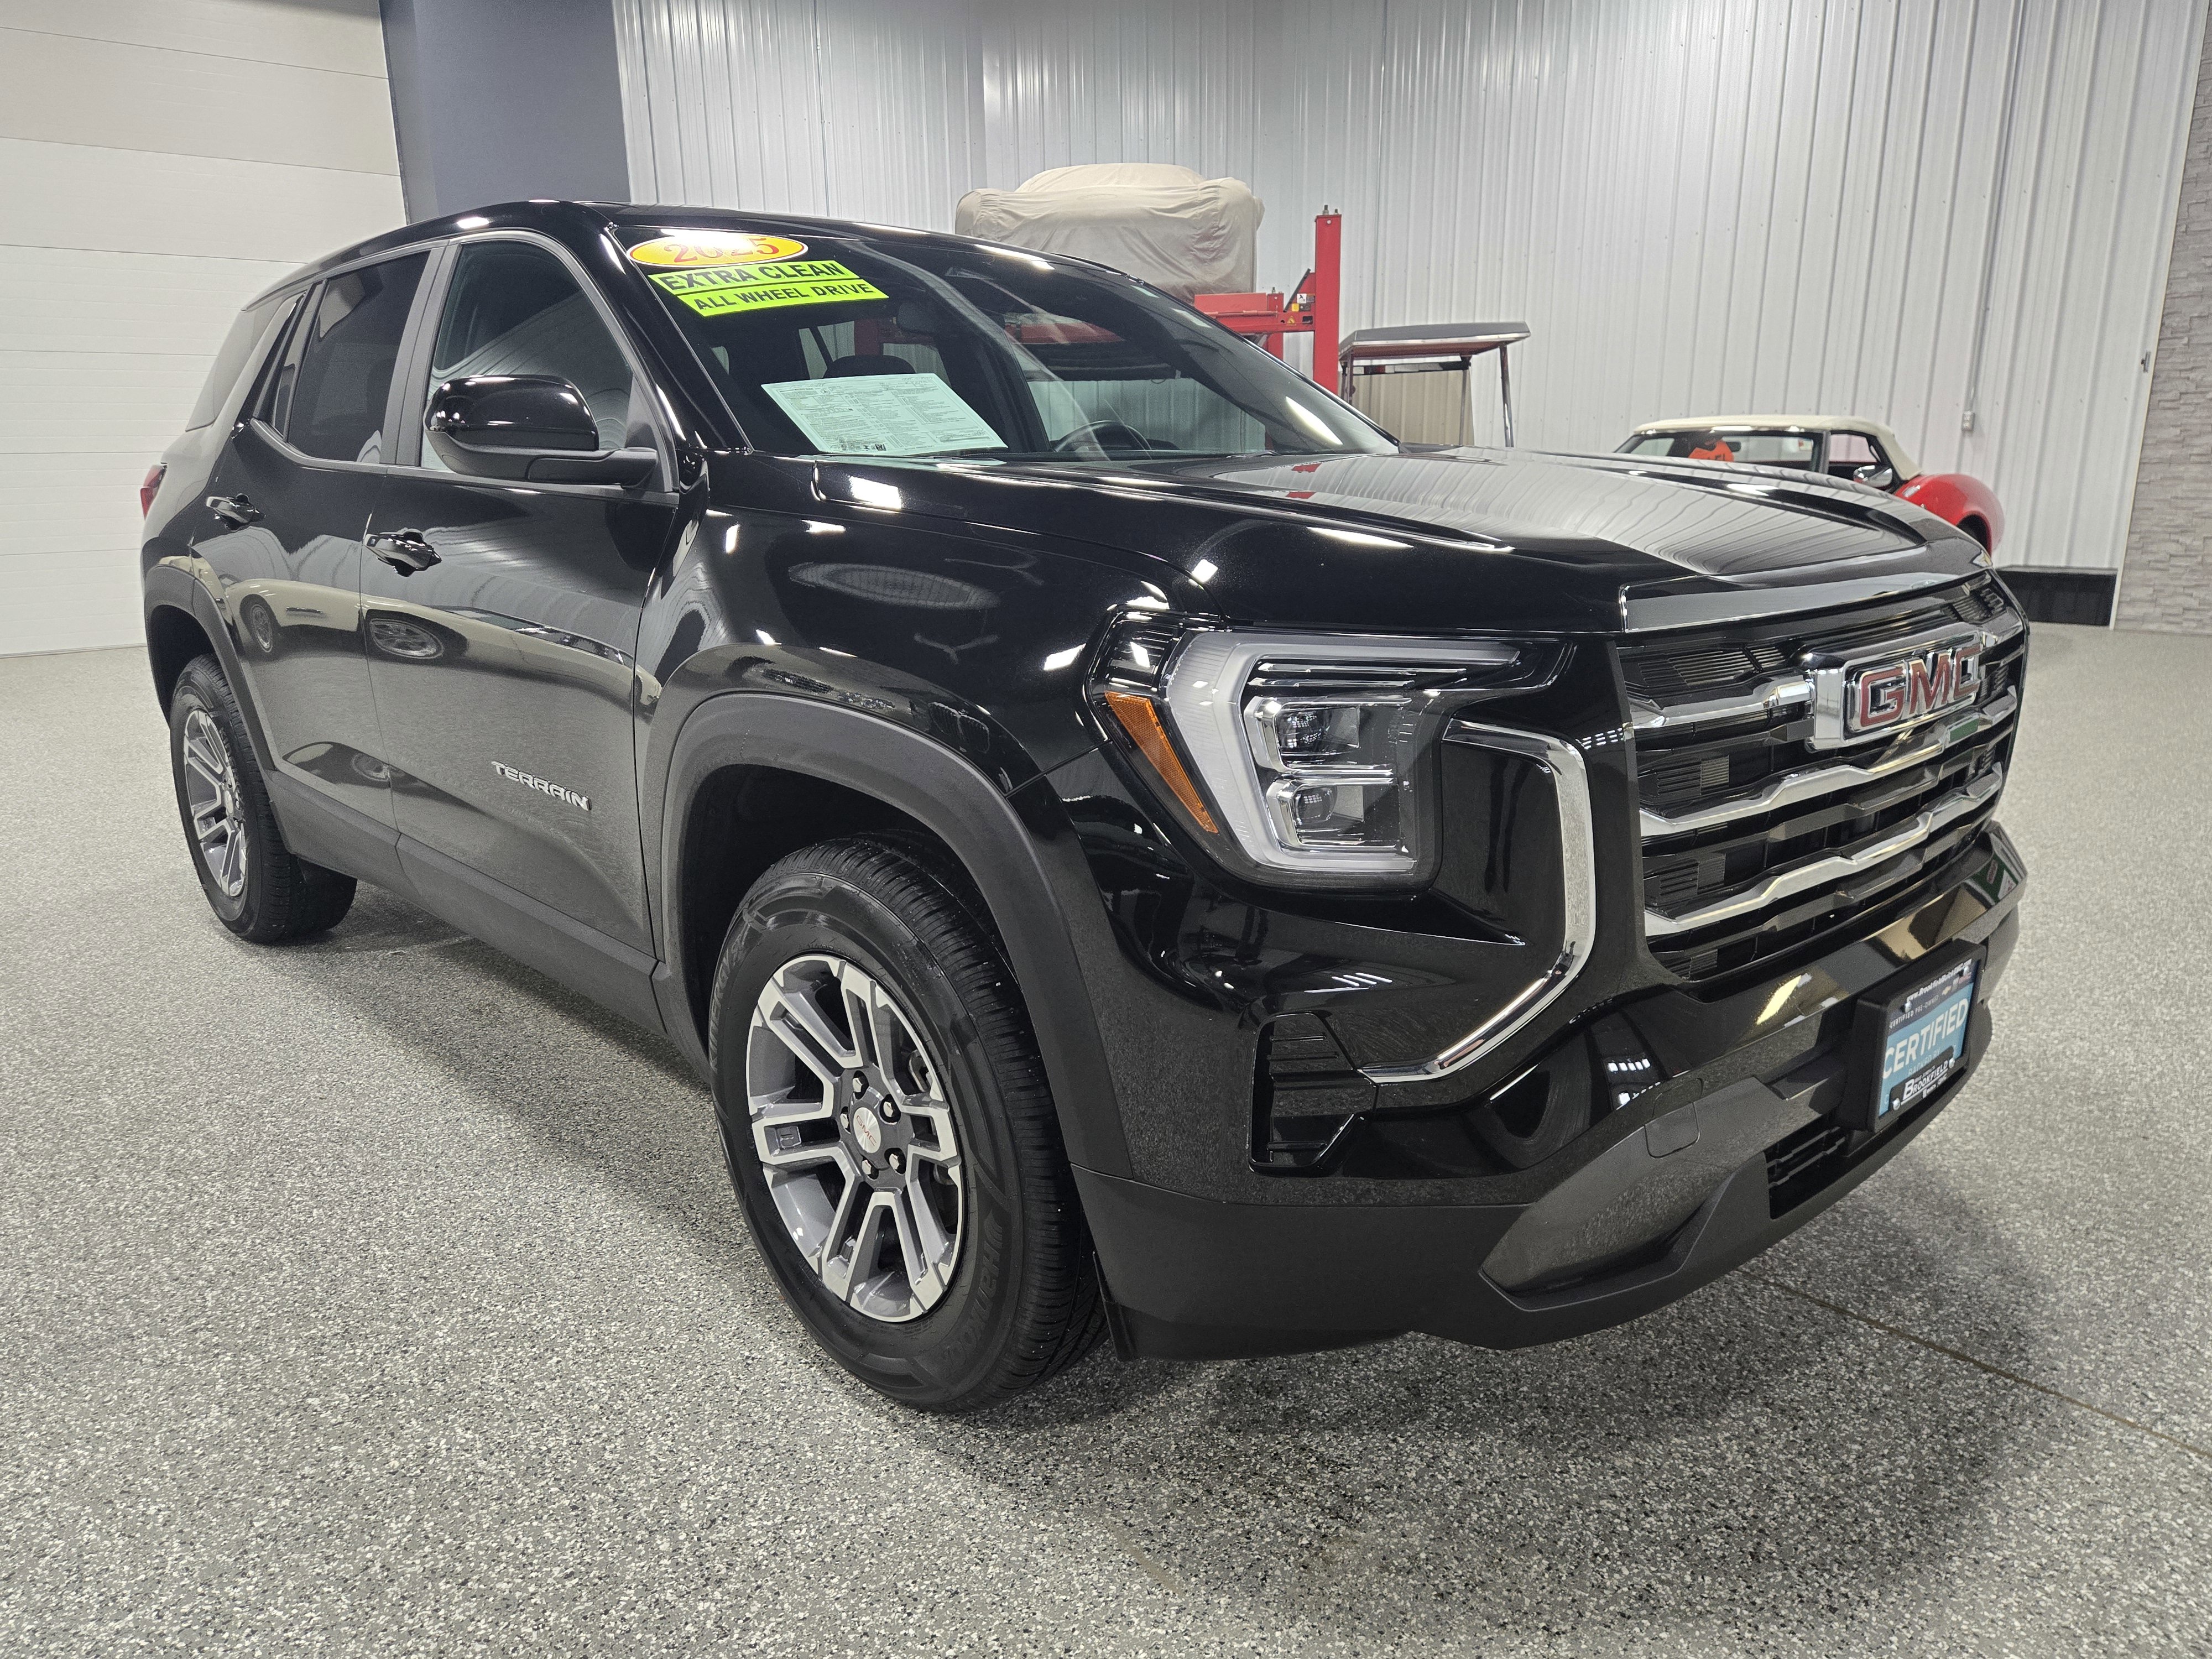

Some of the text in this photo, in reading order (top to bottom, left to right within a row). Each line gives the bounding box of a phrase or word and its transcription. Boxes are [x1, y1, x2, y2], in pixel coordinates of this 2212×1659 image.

[660, 261, 846, 291] EXTRA CLEAN
[693, 284, 874, 310] ALL WHEEL DRIVE
[1860, 643, 1983, 729] GMC
[491, 760, 594, 811] TERRAIN
[1882, 998, 1969, 1079] CERTIFIED
[1902, 1060, 1948, 1100] BROOKFIELD
[856, 1115, 877, 1146] GMC
